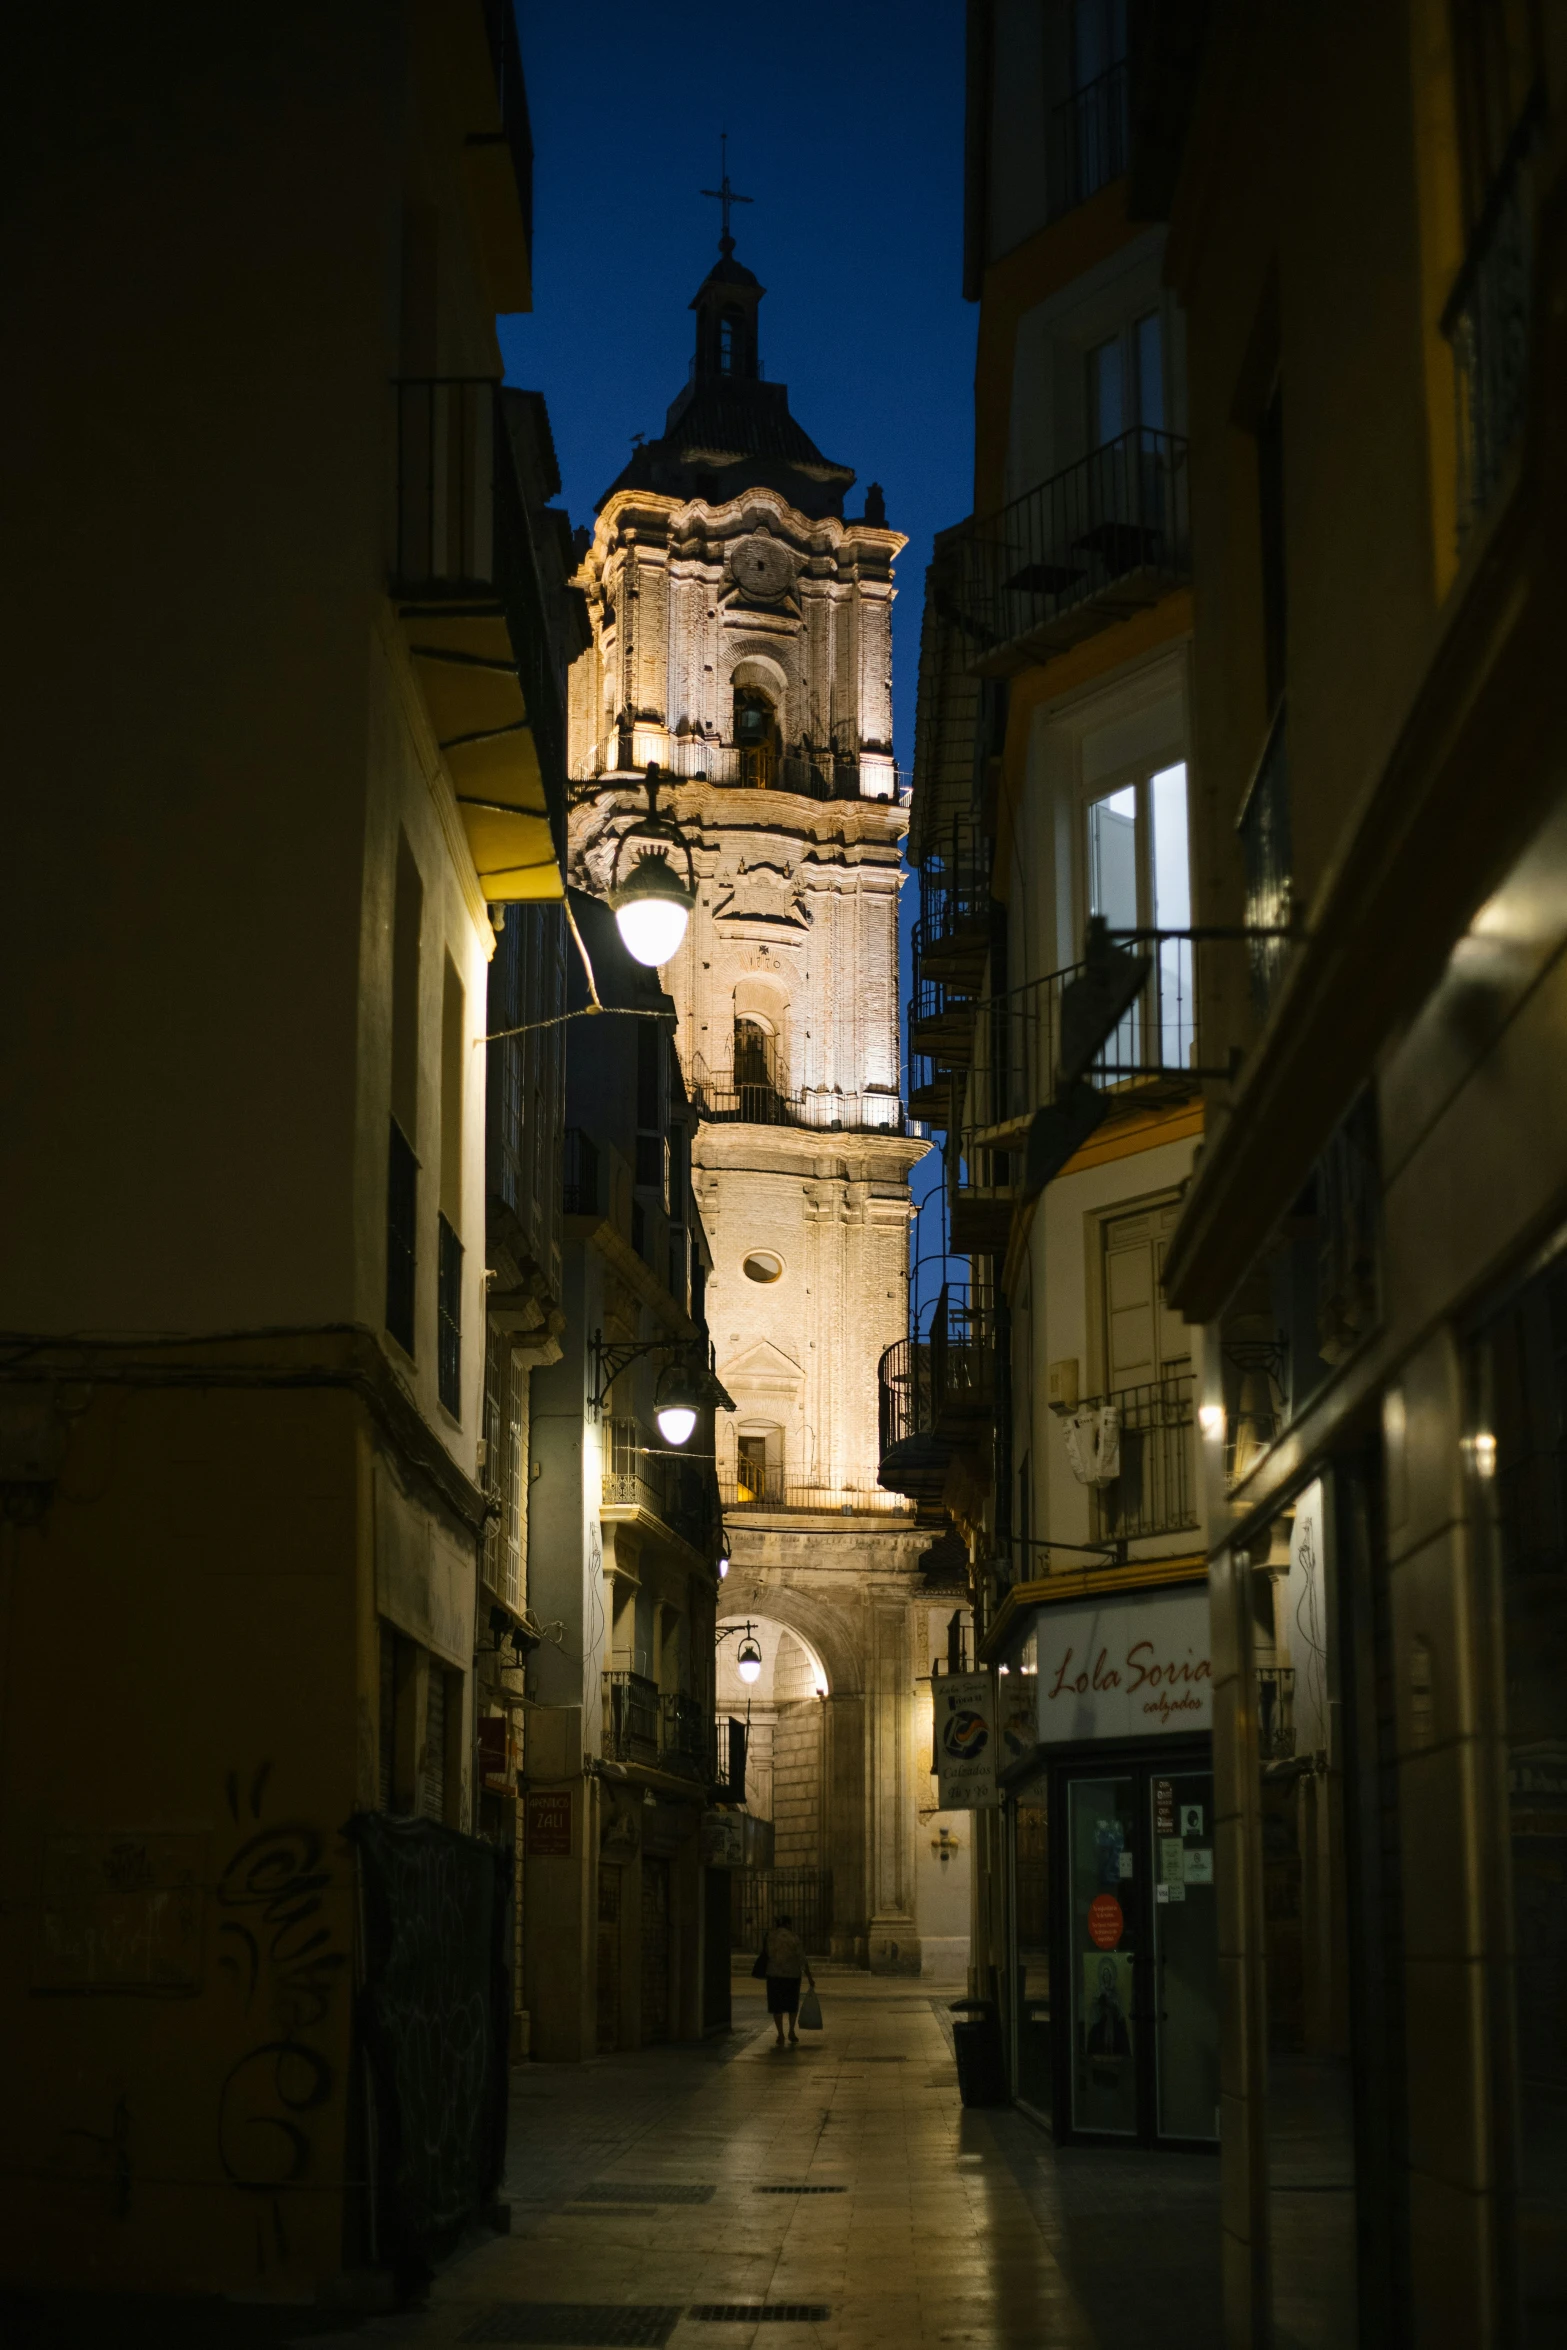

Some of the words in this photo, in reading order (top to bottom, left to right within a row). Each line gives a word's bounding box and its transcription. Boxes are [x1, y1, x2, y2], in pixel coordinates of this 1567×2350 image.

[749, 956, 781, 969] 1770
[1048, 1647, 1122, 1699] Lola
[1125, 1641, 1213, 1694] Soria
[1143, 1689, 1202, 1724] calzados
[943, 1763, 991, 1779] Calzados
[537, 1813, 563, 1828] ZALI
